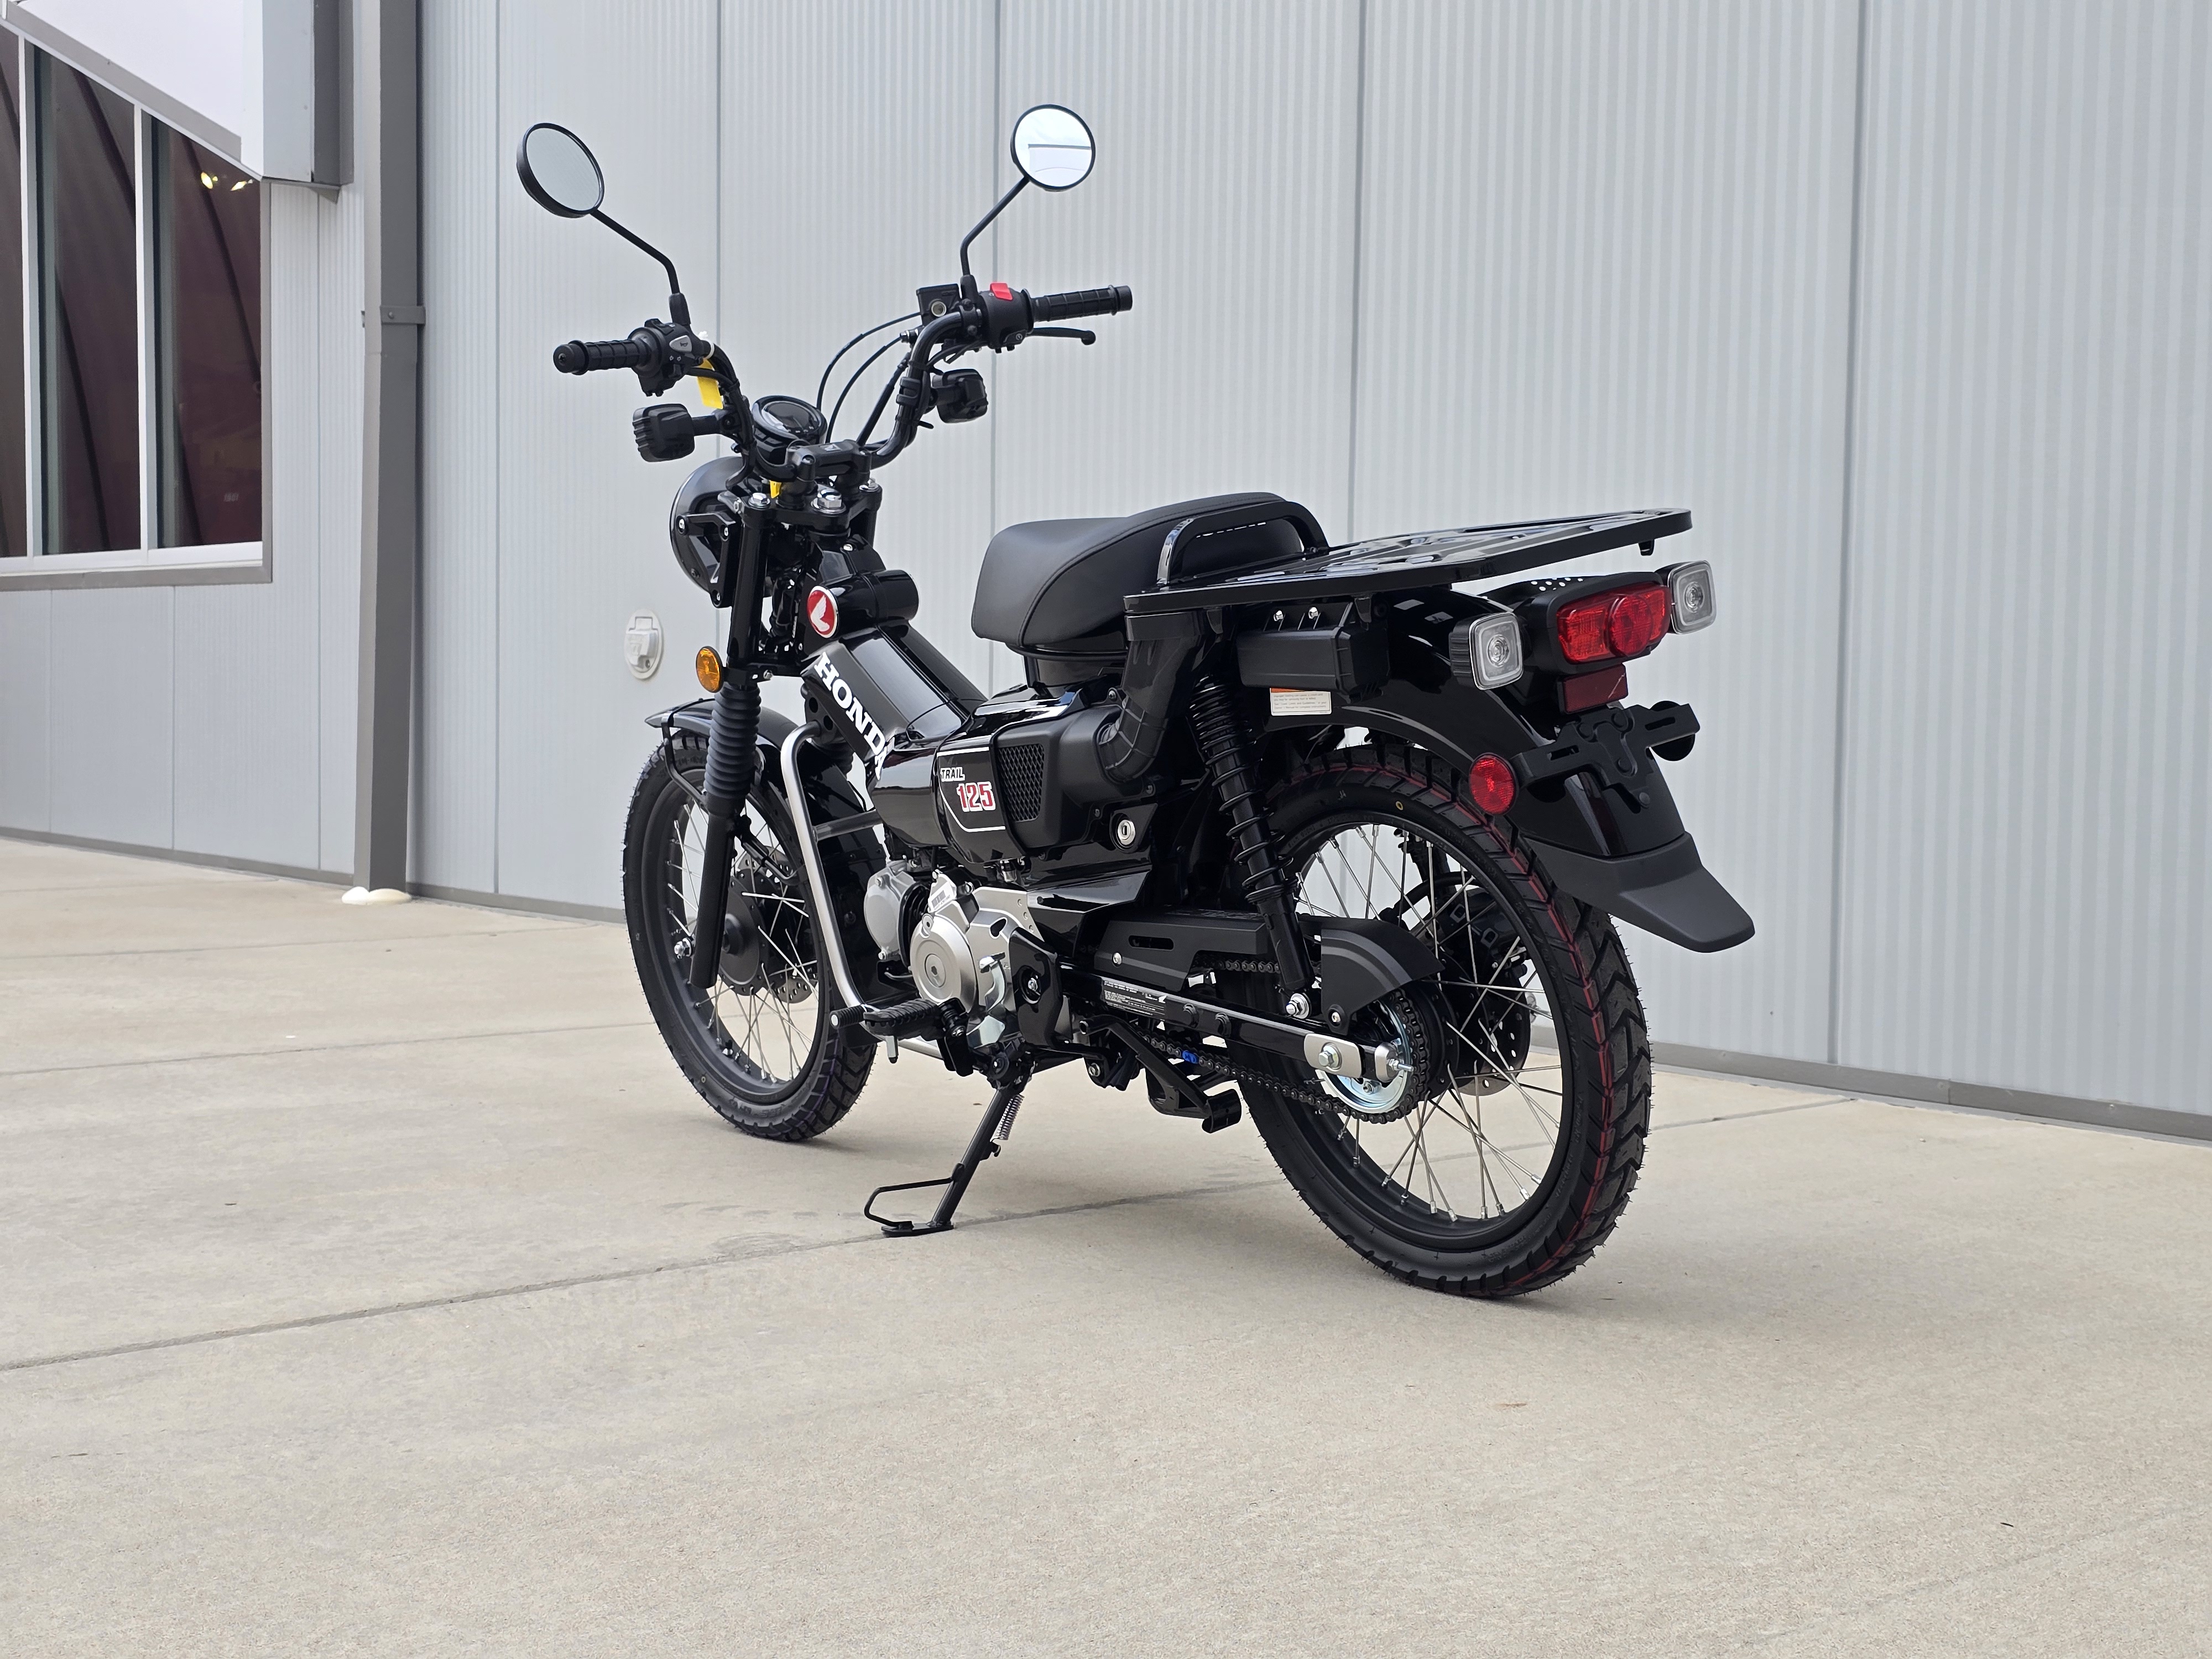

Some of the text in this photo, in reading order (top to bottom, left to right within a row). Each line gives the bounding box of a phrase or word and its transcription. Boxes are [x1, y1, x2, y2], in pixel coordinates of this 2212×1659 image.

[814, 651, 887, 780] HONDA
[941, 768, 964, 780] TRAIL
[957, 782, 994, 810] 125
